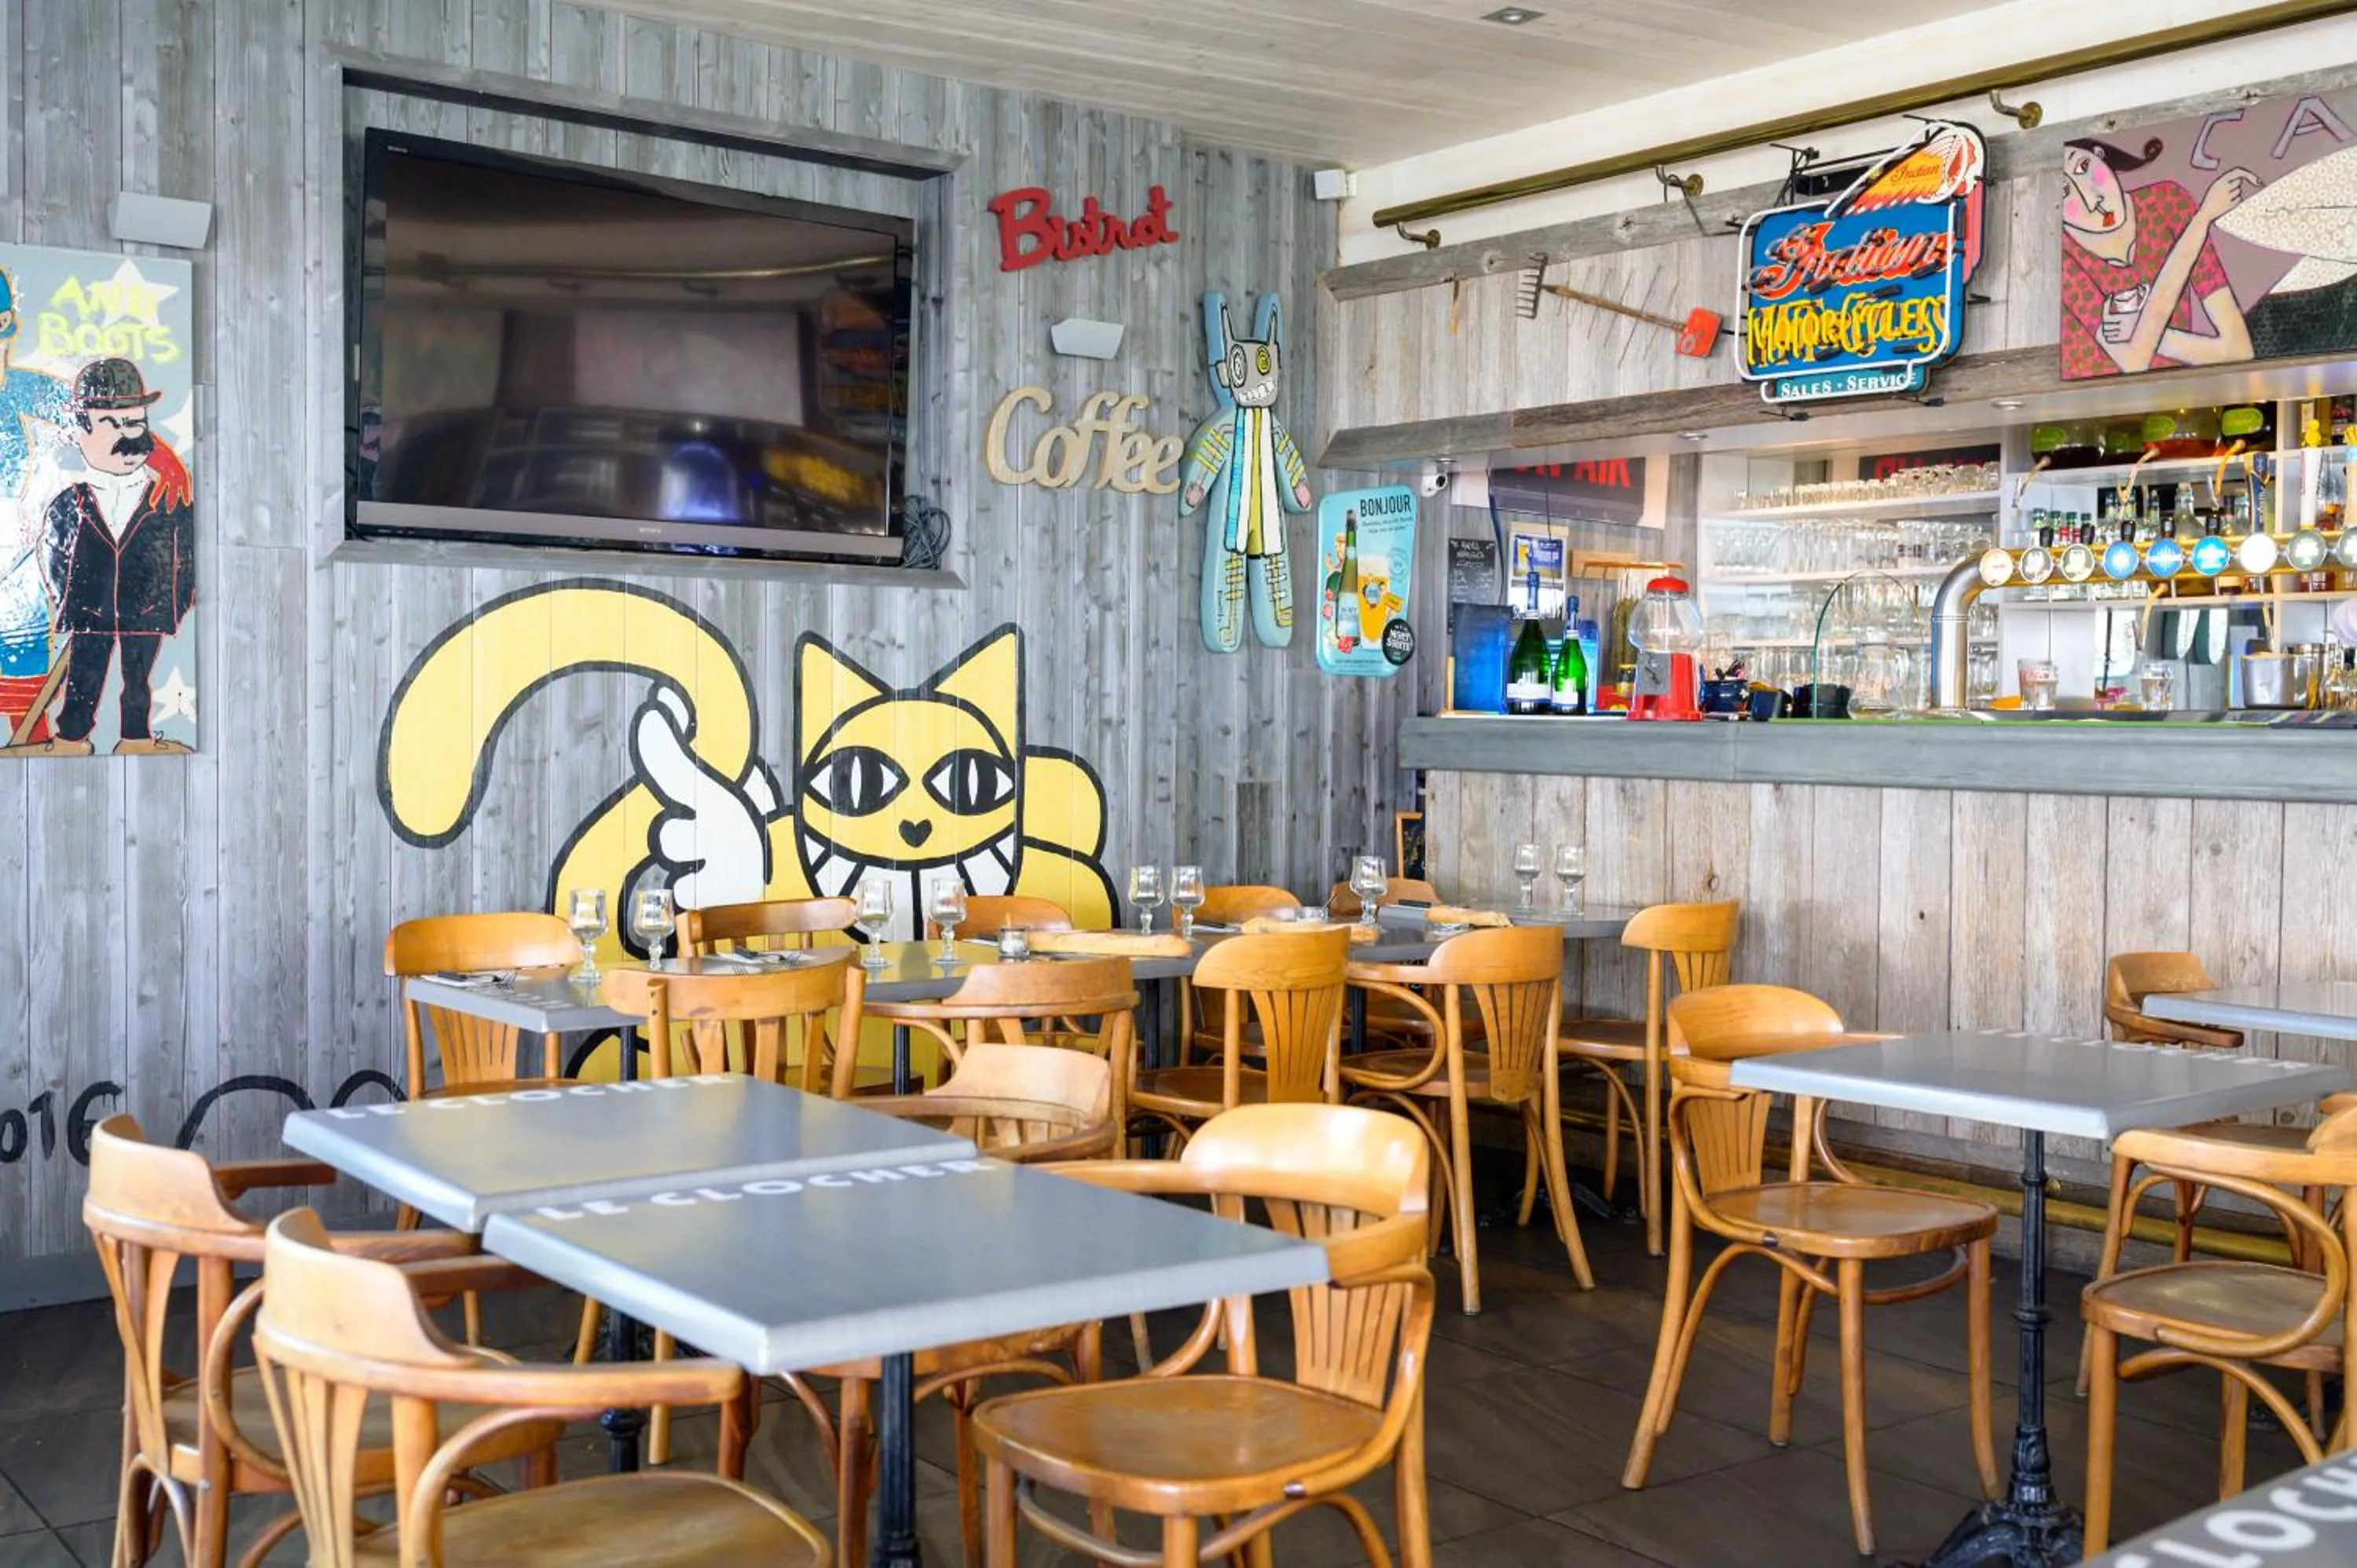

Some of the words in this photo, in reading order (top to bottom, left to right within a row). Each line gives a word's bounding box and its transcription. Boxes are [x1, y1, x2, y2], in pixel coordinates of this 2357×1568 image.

[988, 184, 1179, 272] Bistrot
[1749, 222, 1956, 299] Indian
[38, 311, 182, 365] BOOTS
[1781, 380, 1831, 397] SALES
[1847, 372, 1918, 391] SERVICE
[985, 386, 1184, 494] Coffee
[1360, 495, 1412, 517] BONJOUR
[325, 1102, 407, 1120] LE
[427, 1072, 738, 1110] CLOCHER
[536, 1199, 629, 1222] LE
[651, 1158, 996, 1207] CLOCHER
